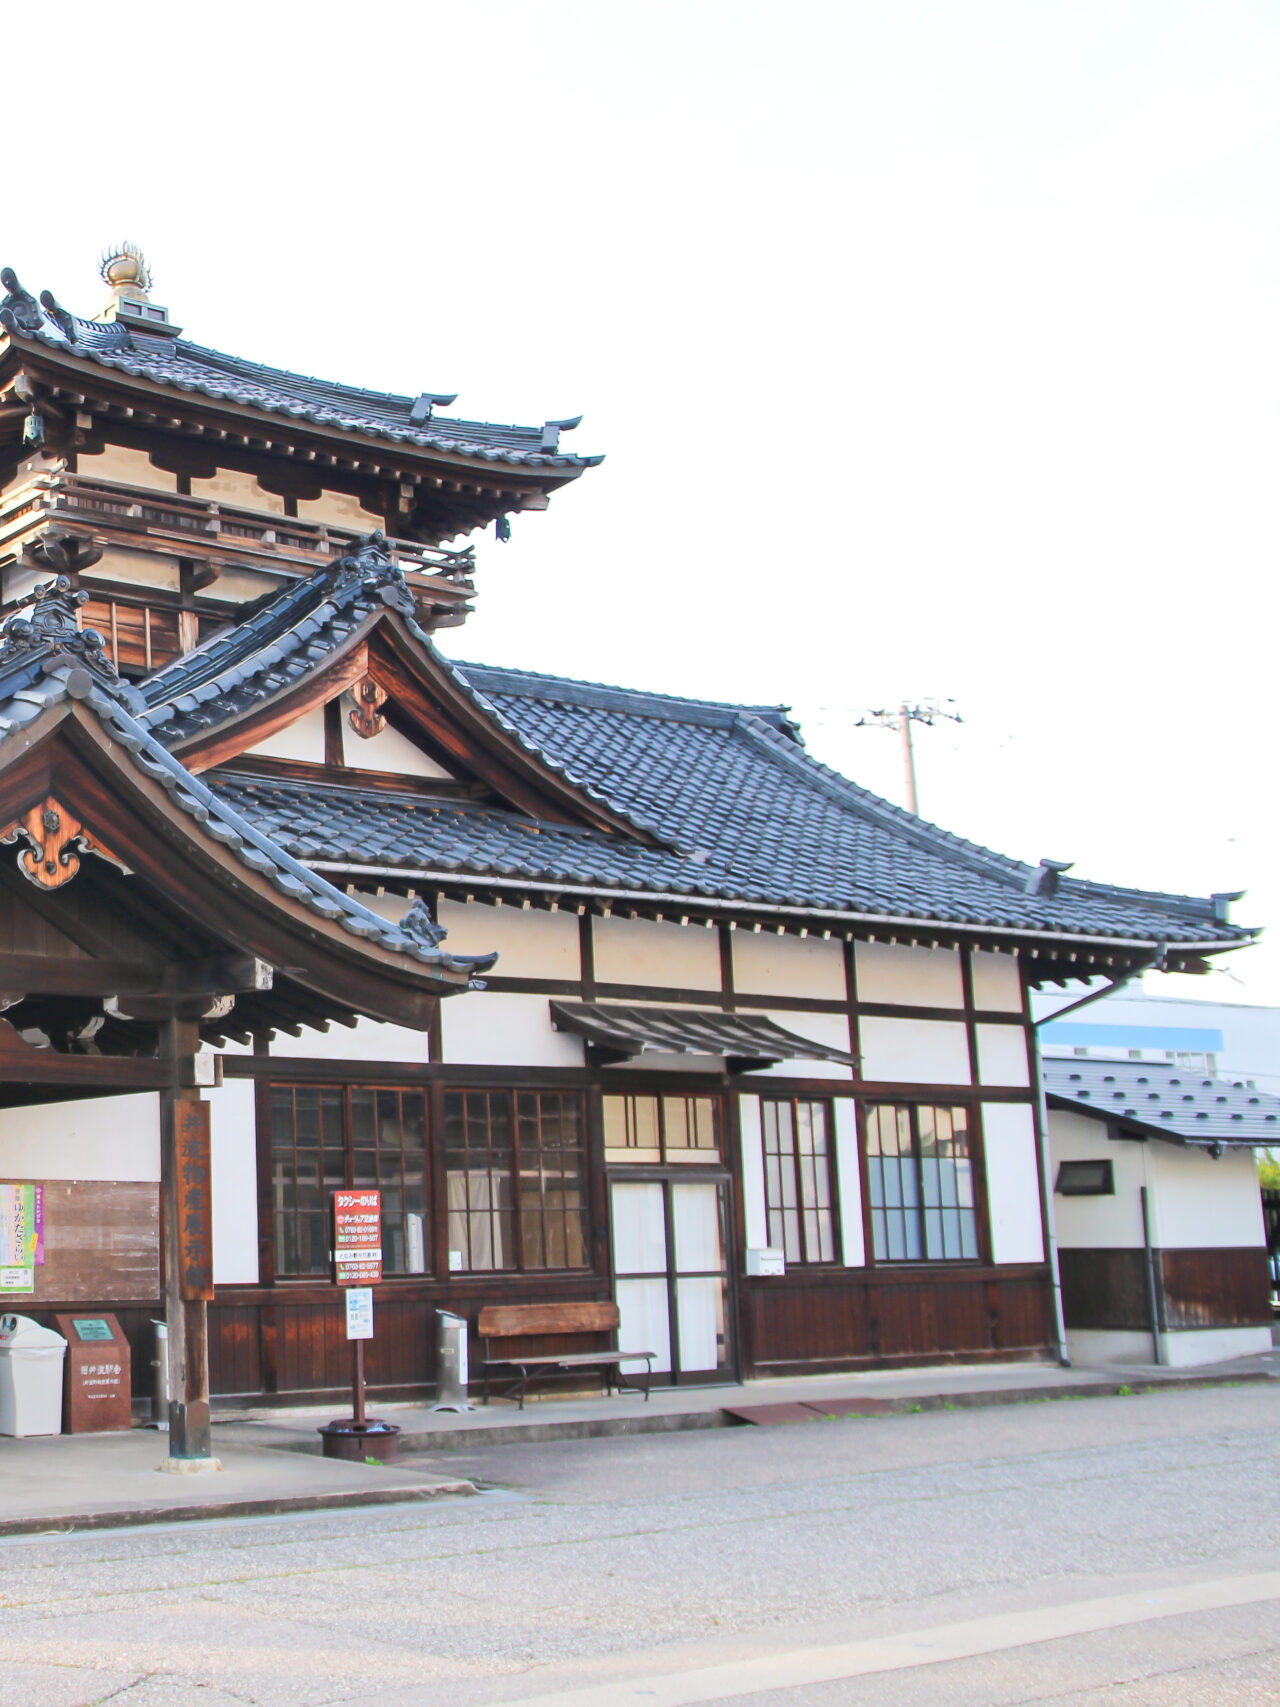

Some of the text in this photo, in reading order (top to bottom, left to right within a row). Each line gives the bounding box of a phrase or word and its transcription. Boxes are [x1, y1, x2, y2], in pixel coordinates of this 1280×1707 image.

[337, 1194, 378, 1207] タクシーのりば
